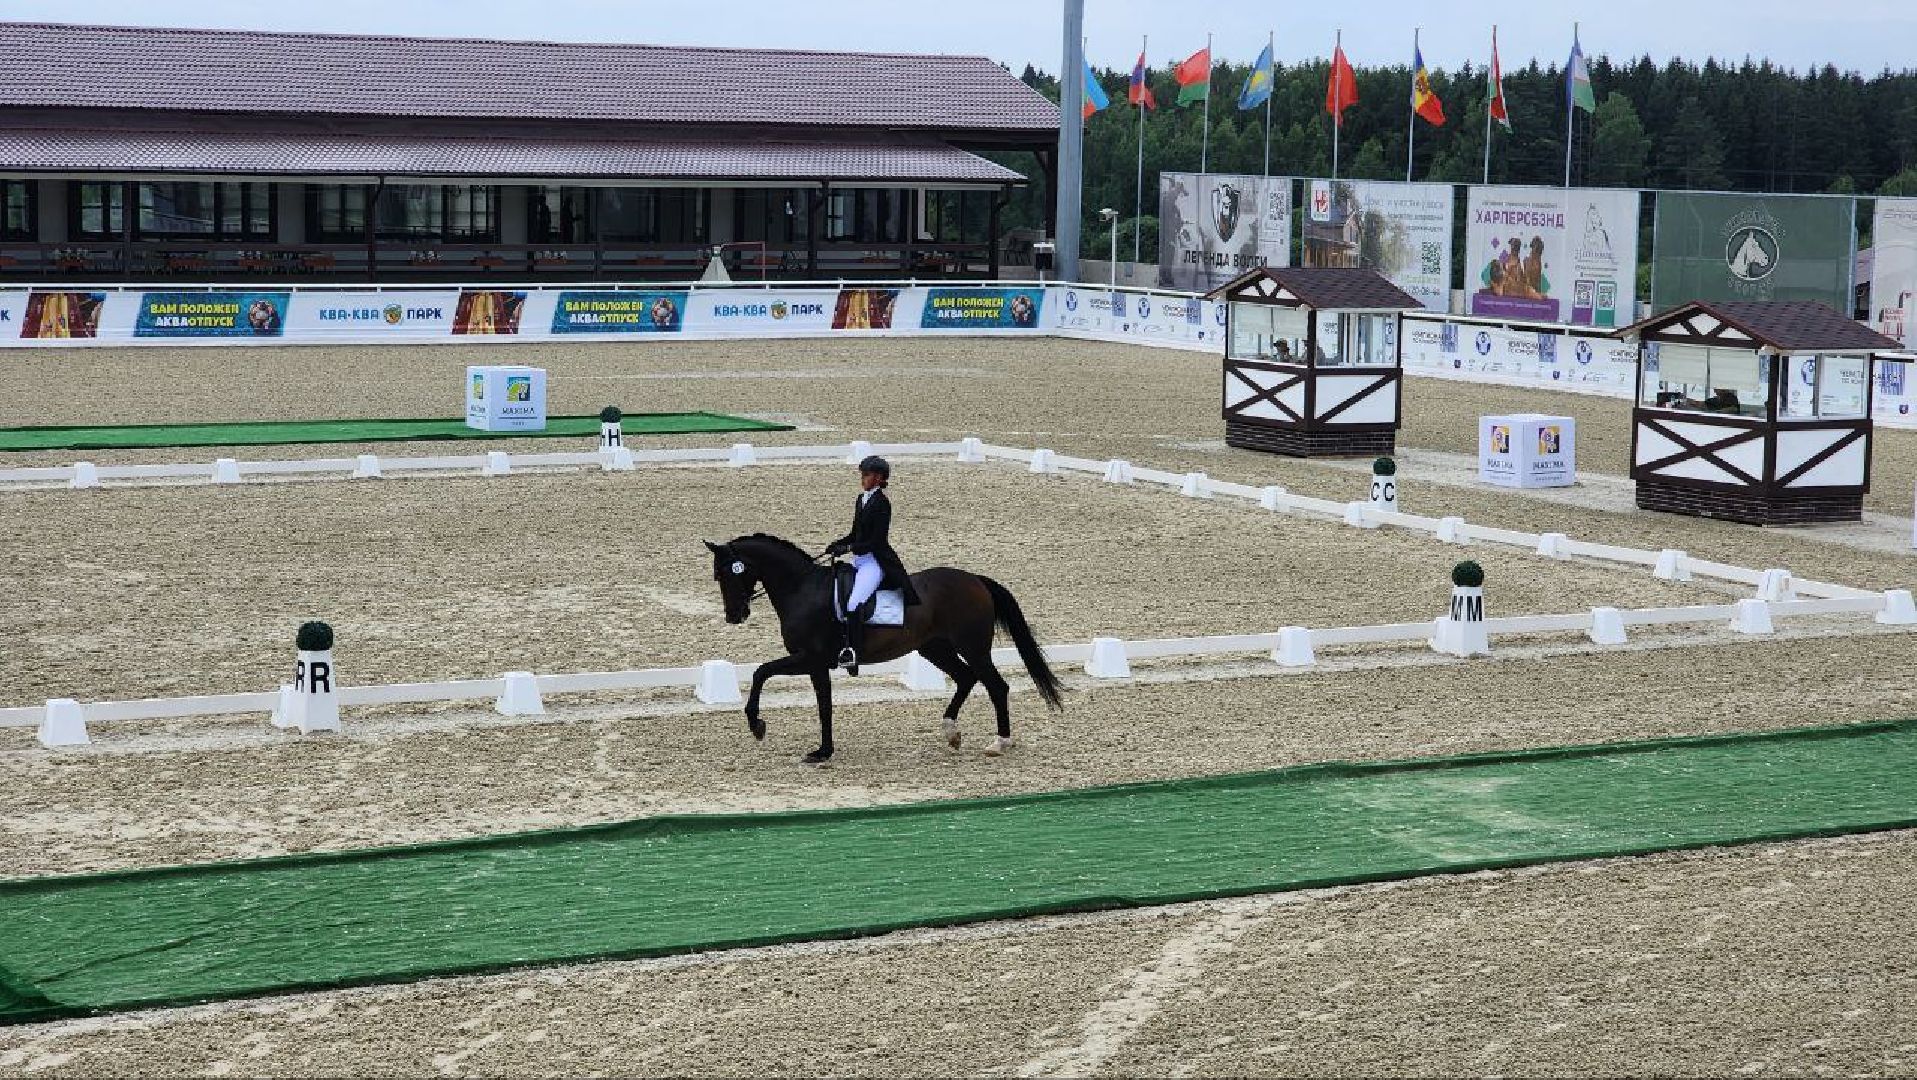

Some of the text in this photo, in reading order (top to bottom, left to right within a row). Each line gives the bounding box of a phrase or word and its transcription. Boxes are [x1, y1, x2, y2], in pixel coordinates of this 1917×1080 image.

[1475, 209, 1565, 229] ХАРПЕРСБЭНД
[1184, 250, 1268, 268] ЛЕГЕНДА ВОЛГИ
[150, 303, 239, 315] ВАМ ПОЛОЖЕН
[407, 308, 442, 320] ПАРК
[565, 301, 643, 312] ВАМ ПОЛОЖЕН
[792, 304, 823, 316] ПАРК
[154, 316, 234, 328] АКВАОТПУСК
[570, 313, 639, 324] АКВАОТПУСК
[608, 428, 620, 446] H
[1371, 482, 1380, 501] C
[1384, 482, 1395, 501] C
[1466, 595, 1482, 622] M
[295, 660, 305, 693] R
[310, 661, 330, 693] R
